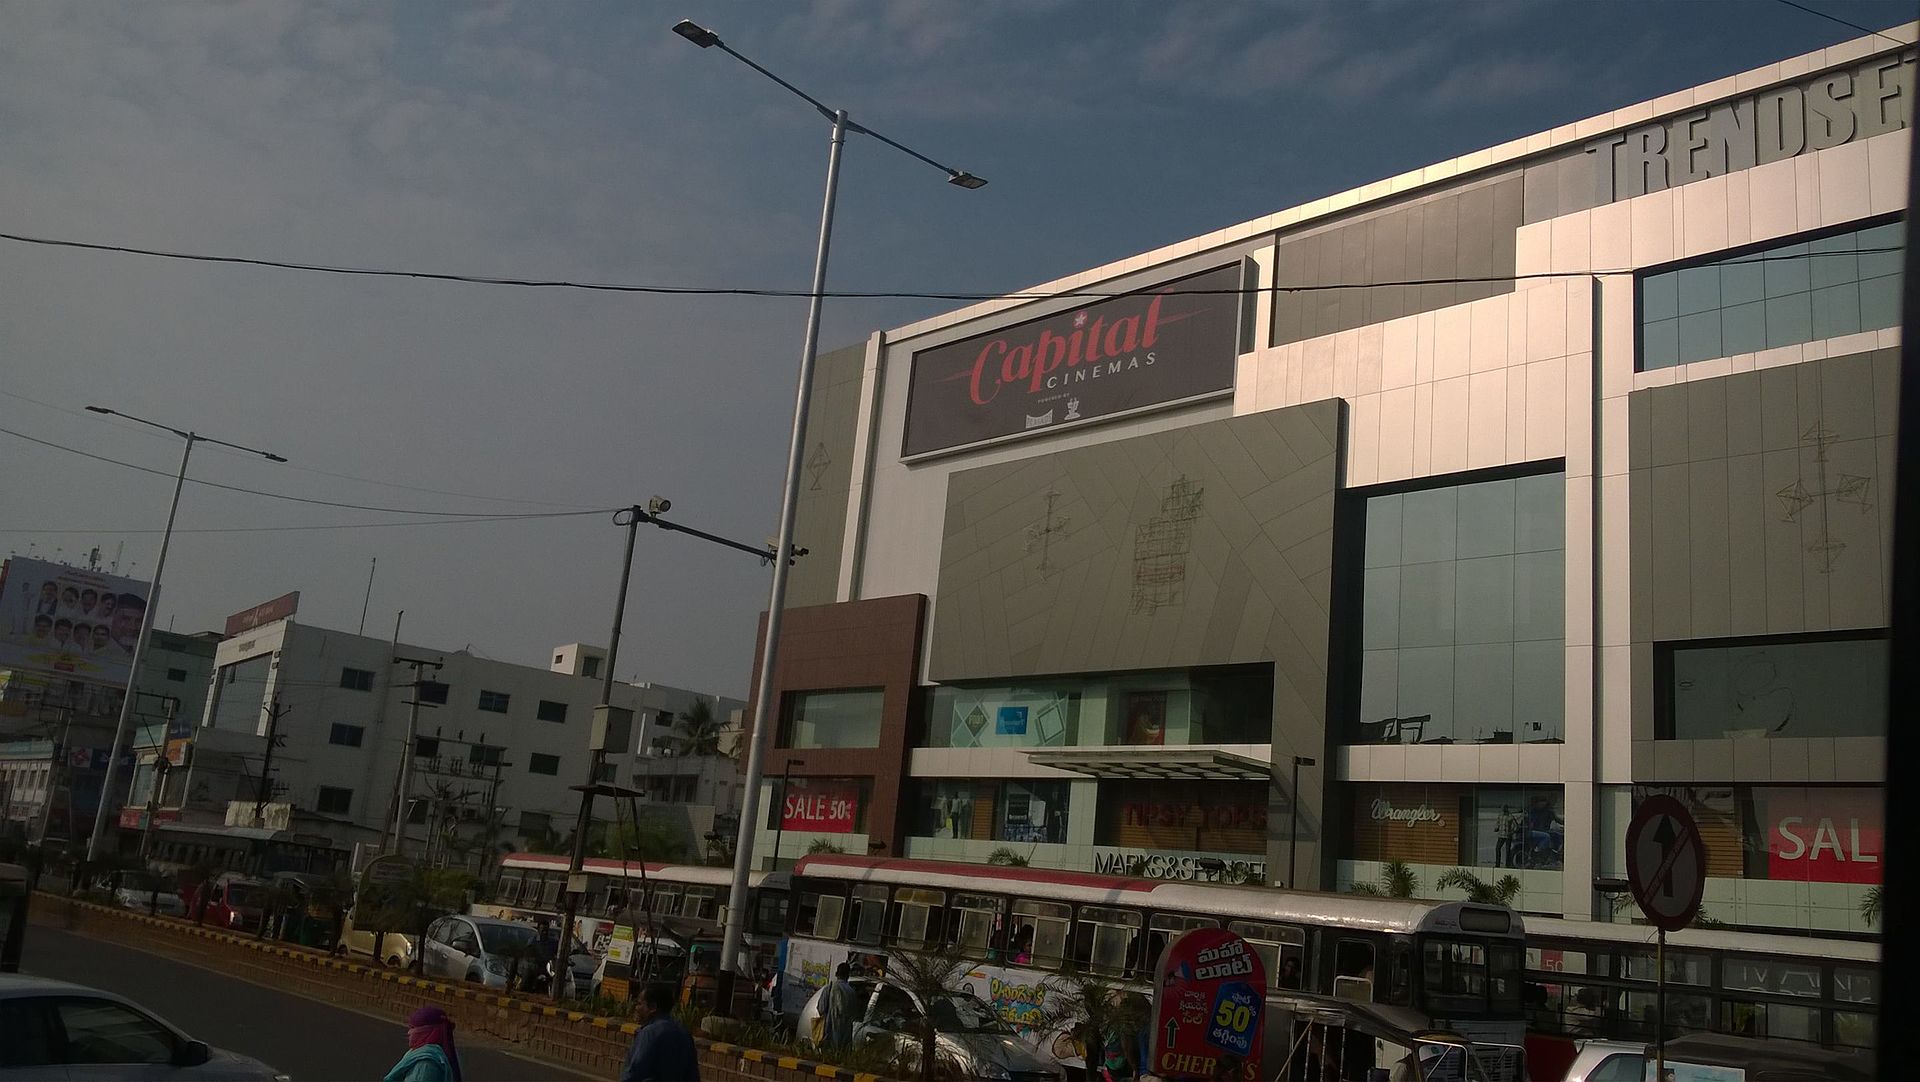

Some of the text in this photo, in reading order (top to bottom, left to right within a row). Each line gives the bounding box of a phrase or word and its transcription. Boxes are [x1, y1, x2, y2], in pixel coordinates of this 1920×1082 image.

[964, 286, 1180, 405] Capital
[1046, 351, 1157, 389] CINEMAS
[784, 794, 827, 820] SALE
[1371, 798, 1441, 828] Wrangler
[1778, 817, 1878, 862] SAL
